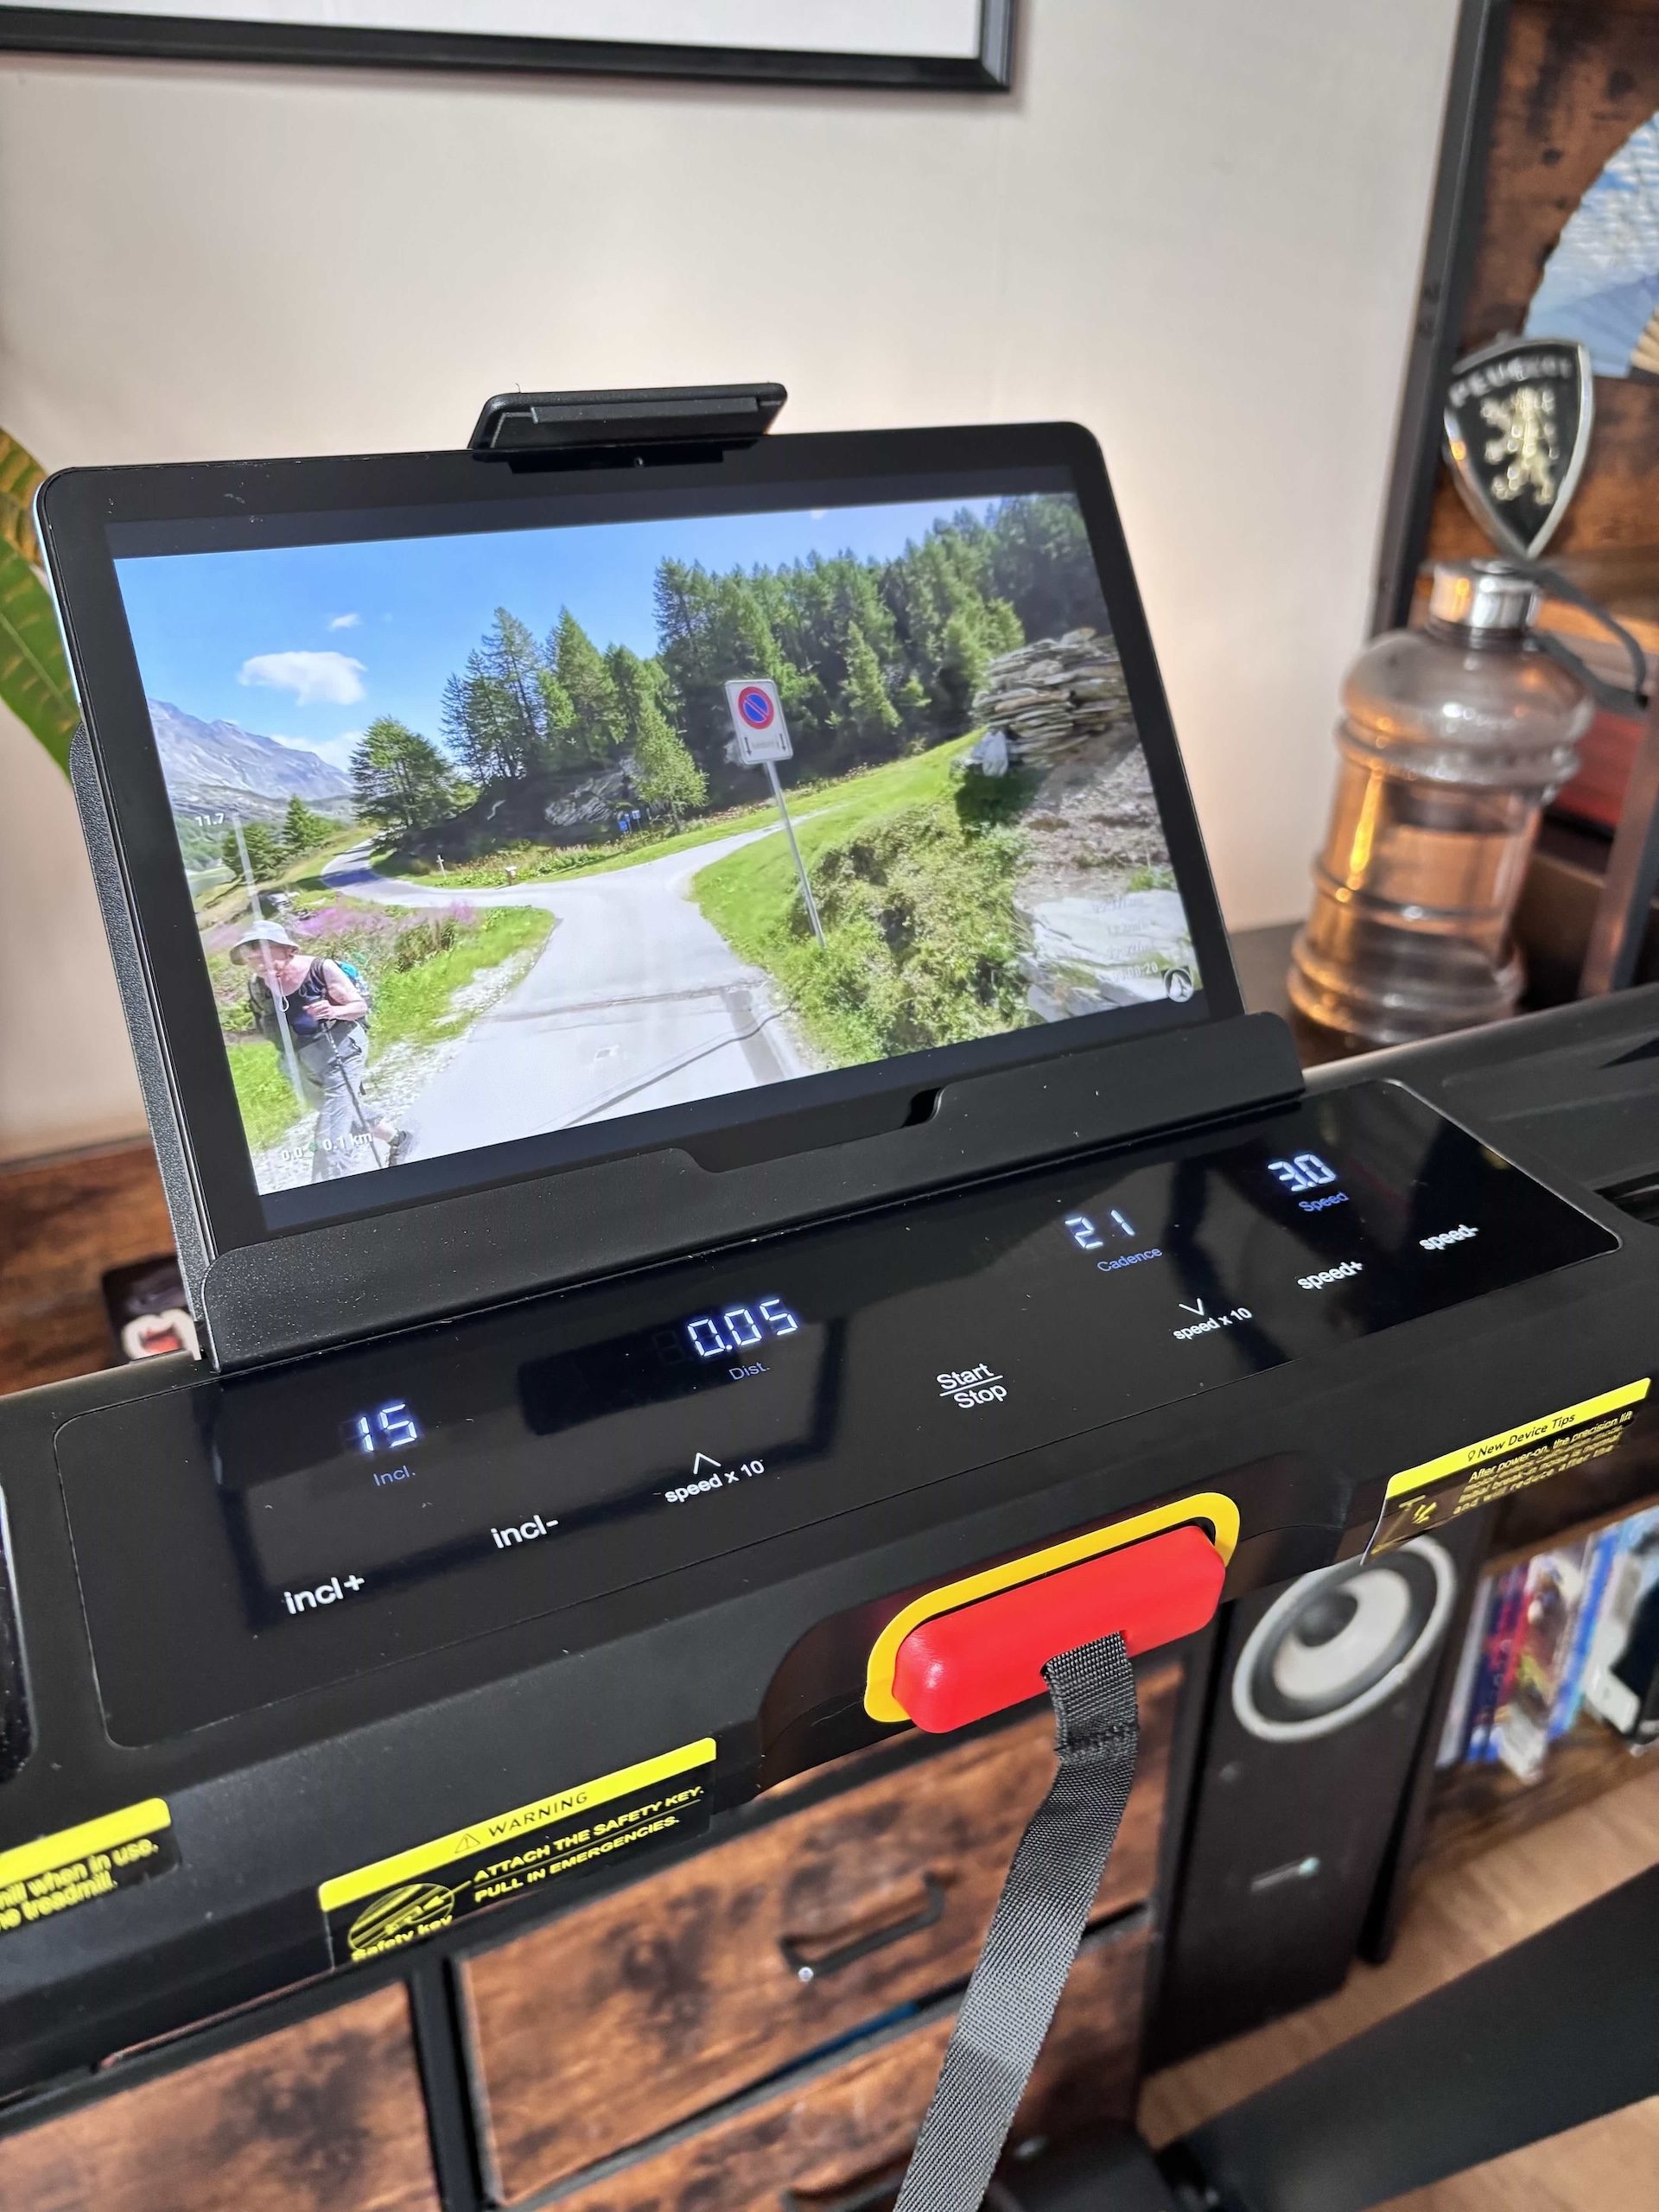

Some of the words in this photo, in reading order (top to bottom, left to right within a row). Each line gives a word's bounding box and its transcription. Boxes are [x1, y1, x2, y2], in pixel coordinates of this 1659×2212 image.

[194, 812, 225, 827] 11.7
[282, 1147, 303, 1160] 0.0
[349, 1132, 373, 1147] km
[1268, 1154, 1337, 1192] 3.0
[1298, 1192, 1350, 1212] Speed
[1065, 1210, 1135, 1249] 21
[1096, 1248, 1163, 1272] Cadence
[1297, 1261, 1363, 1290] speed+
[688, 1299, 798, 1357] 0.05
[1173, 1318, 1221, 1340] speed
[1217, 1314, 1233, 1325] x
[1230, 1307, 1253, 1319] 10
[728, 1361, 771, 1381] Dist.
[936, 1363, 995, 1389] Start
[953, 1385, 1007, 1408] Stop
[360, 1403, 417, 1452] 15
[1478, 1441, 1506, 1459] New
[1508, 1424, 1548, 1446] Device
[1552, 1414, 1575, 1429] Tips
[373, 1465, 416, 1486] Incl.
[664, 1473, 723, 1503] speed
[724, 1471, 740, 1484] x
[741, 1460, 765, 1477] 10
[1469, 1465, 1497, 1483] After
[491, 1515, 559, 1549] incl-
[283, 1574, 365, 1615] incl+
[488, 1791, 588, 1837] WARNING
[474, 1845, 550, 1883] ATTACH
[553, 1829, 591, 1850] THE
[593, 1801, 663, 1836] SAFETY
[664, 1786, 705, 1807] KEY.
[87, 1854, 112, 1875] in
[474, 1878, 524, 1903] PULL
[527, 1868, 546, 1883] IN
[550, 1815, 680, 1874] EMERGENCIES.
